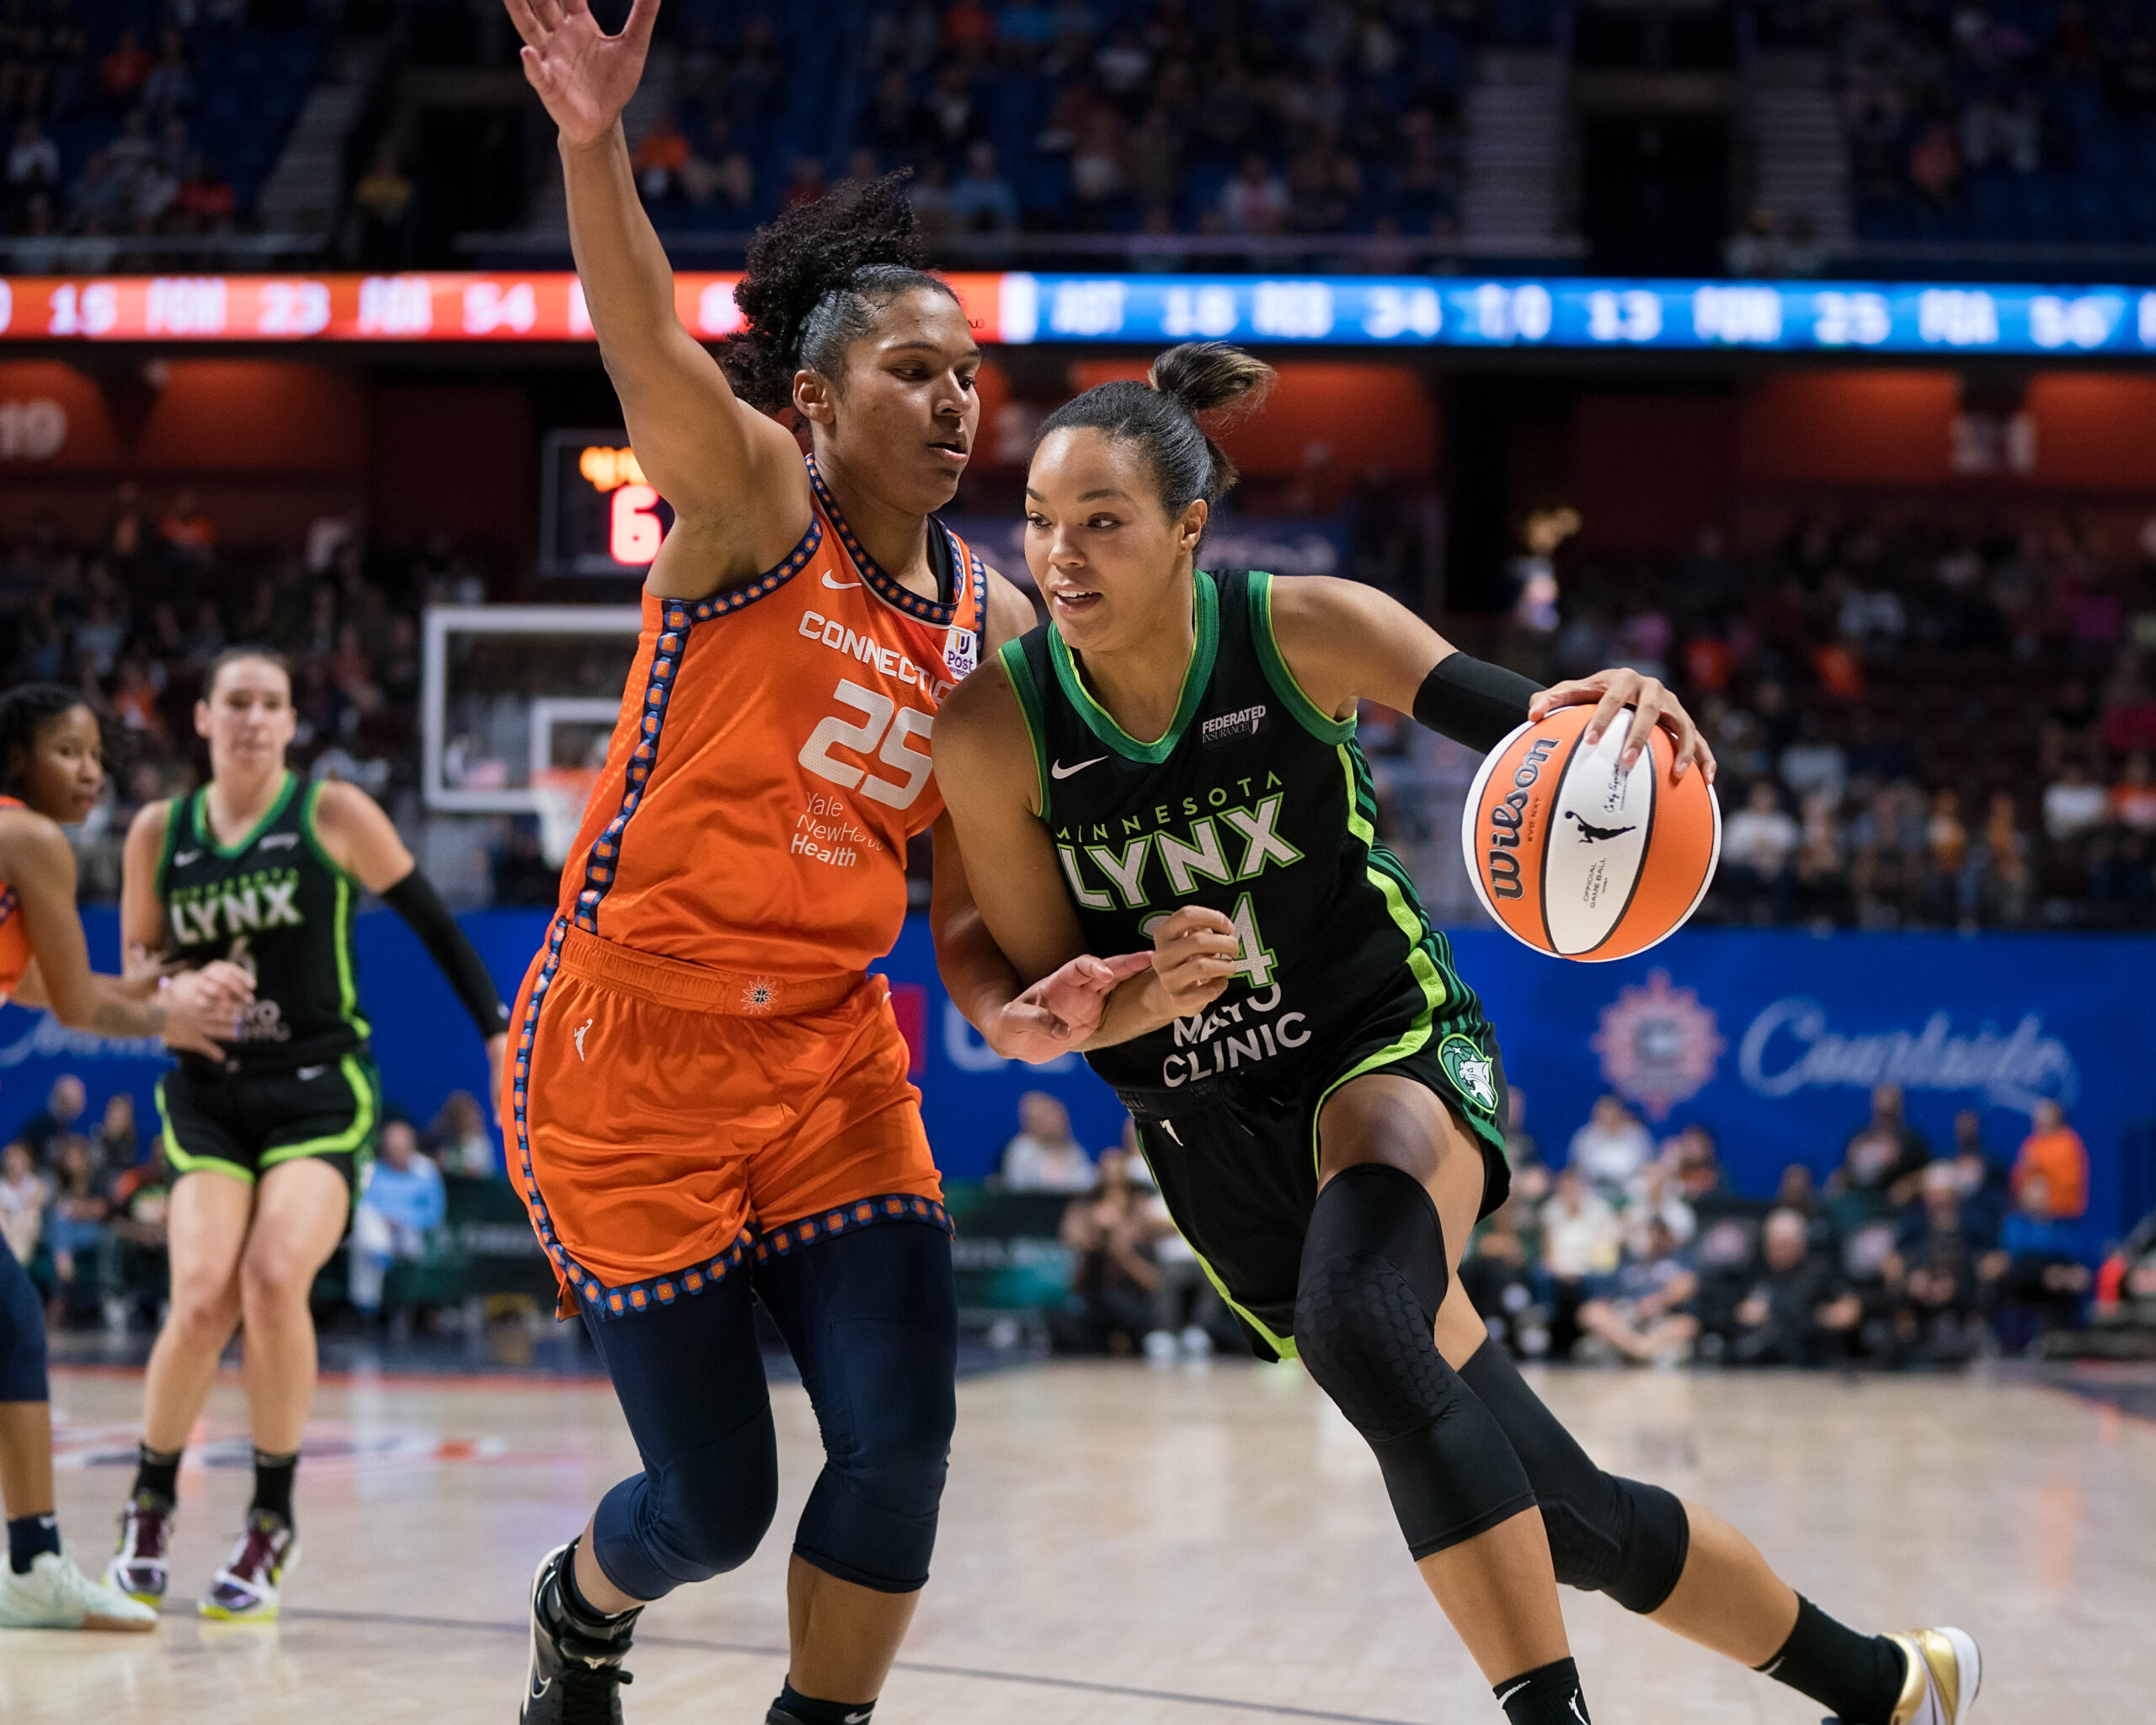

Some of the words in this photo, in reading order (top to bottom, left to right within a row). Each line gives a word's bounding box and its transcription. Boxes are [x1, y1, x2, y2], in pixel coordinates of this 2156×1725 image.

[257, 281, 330, 335] 23
[611, 483, 663, 565] 6
[798, 611, 958, 706] CONNECTIC
[947, 649, 974, 672] Post
[798, 678, 934, 809] 25
[1202, 705, 1267, 734] FEDERATED
[1202, 722, 1247, 744] INSURANCE
[806, 792, 843, 817] Yale
[1489, 737, 1561, 900] Wilson
[791, 833, 857, 867] Health
[1057, 792, 1306, 911] LYNX
[1583, 862, 1597, 902] OFFICIAL
[1589, 883, 1600, 909] GAME
[1596, 857, 1606, 881] BALL
[171, 882, 304, 945] LYNX
[1139, 891, 1278, 989] 4
[1163, 1012, 1312, 1087] CLINIC
